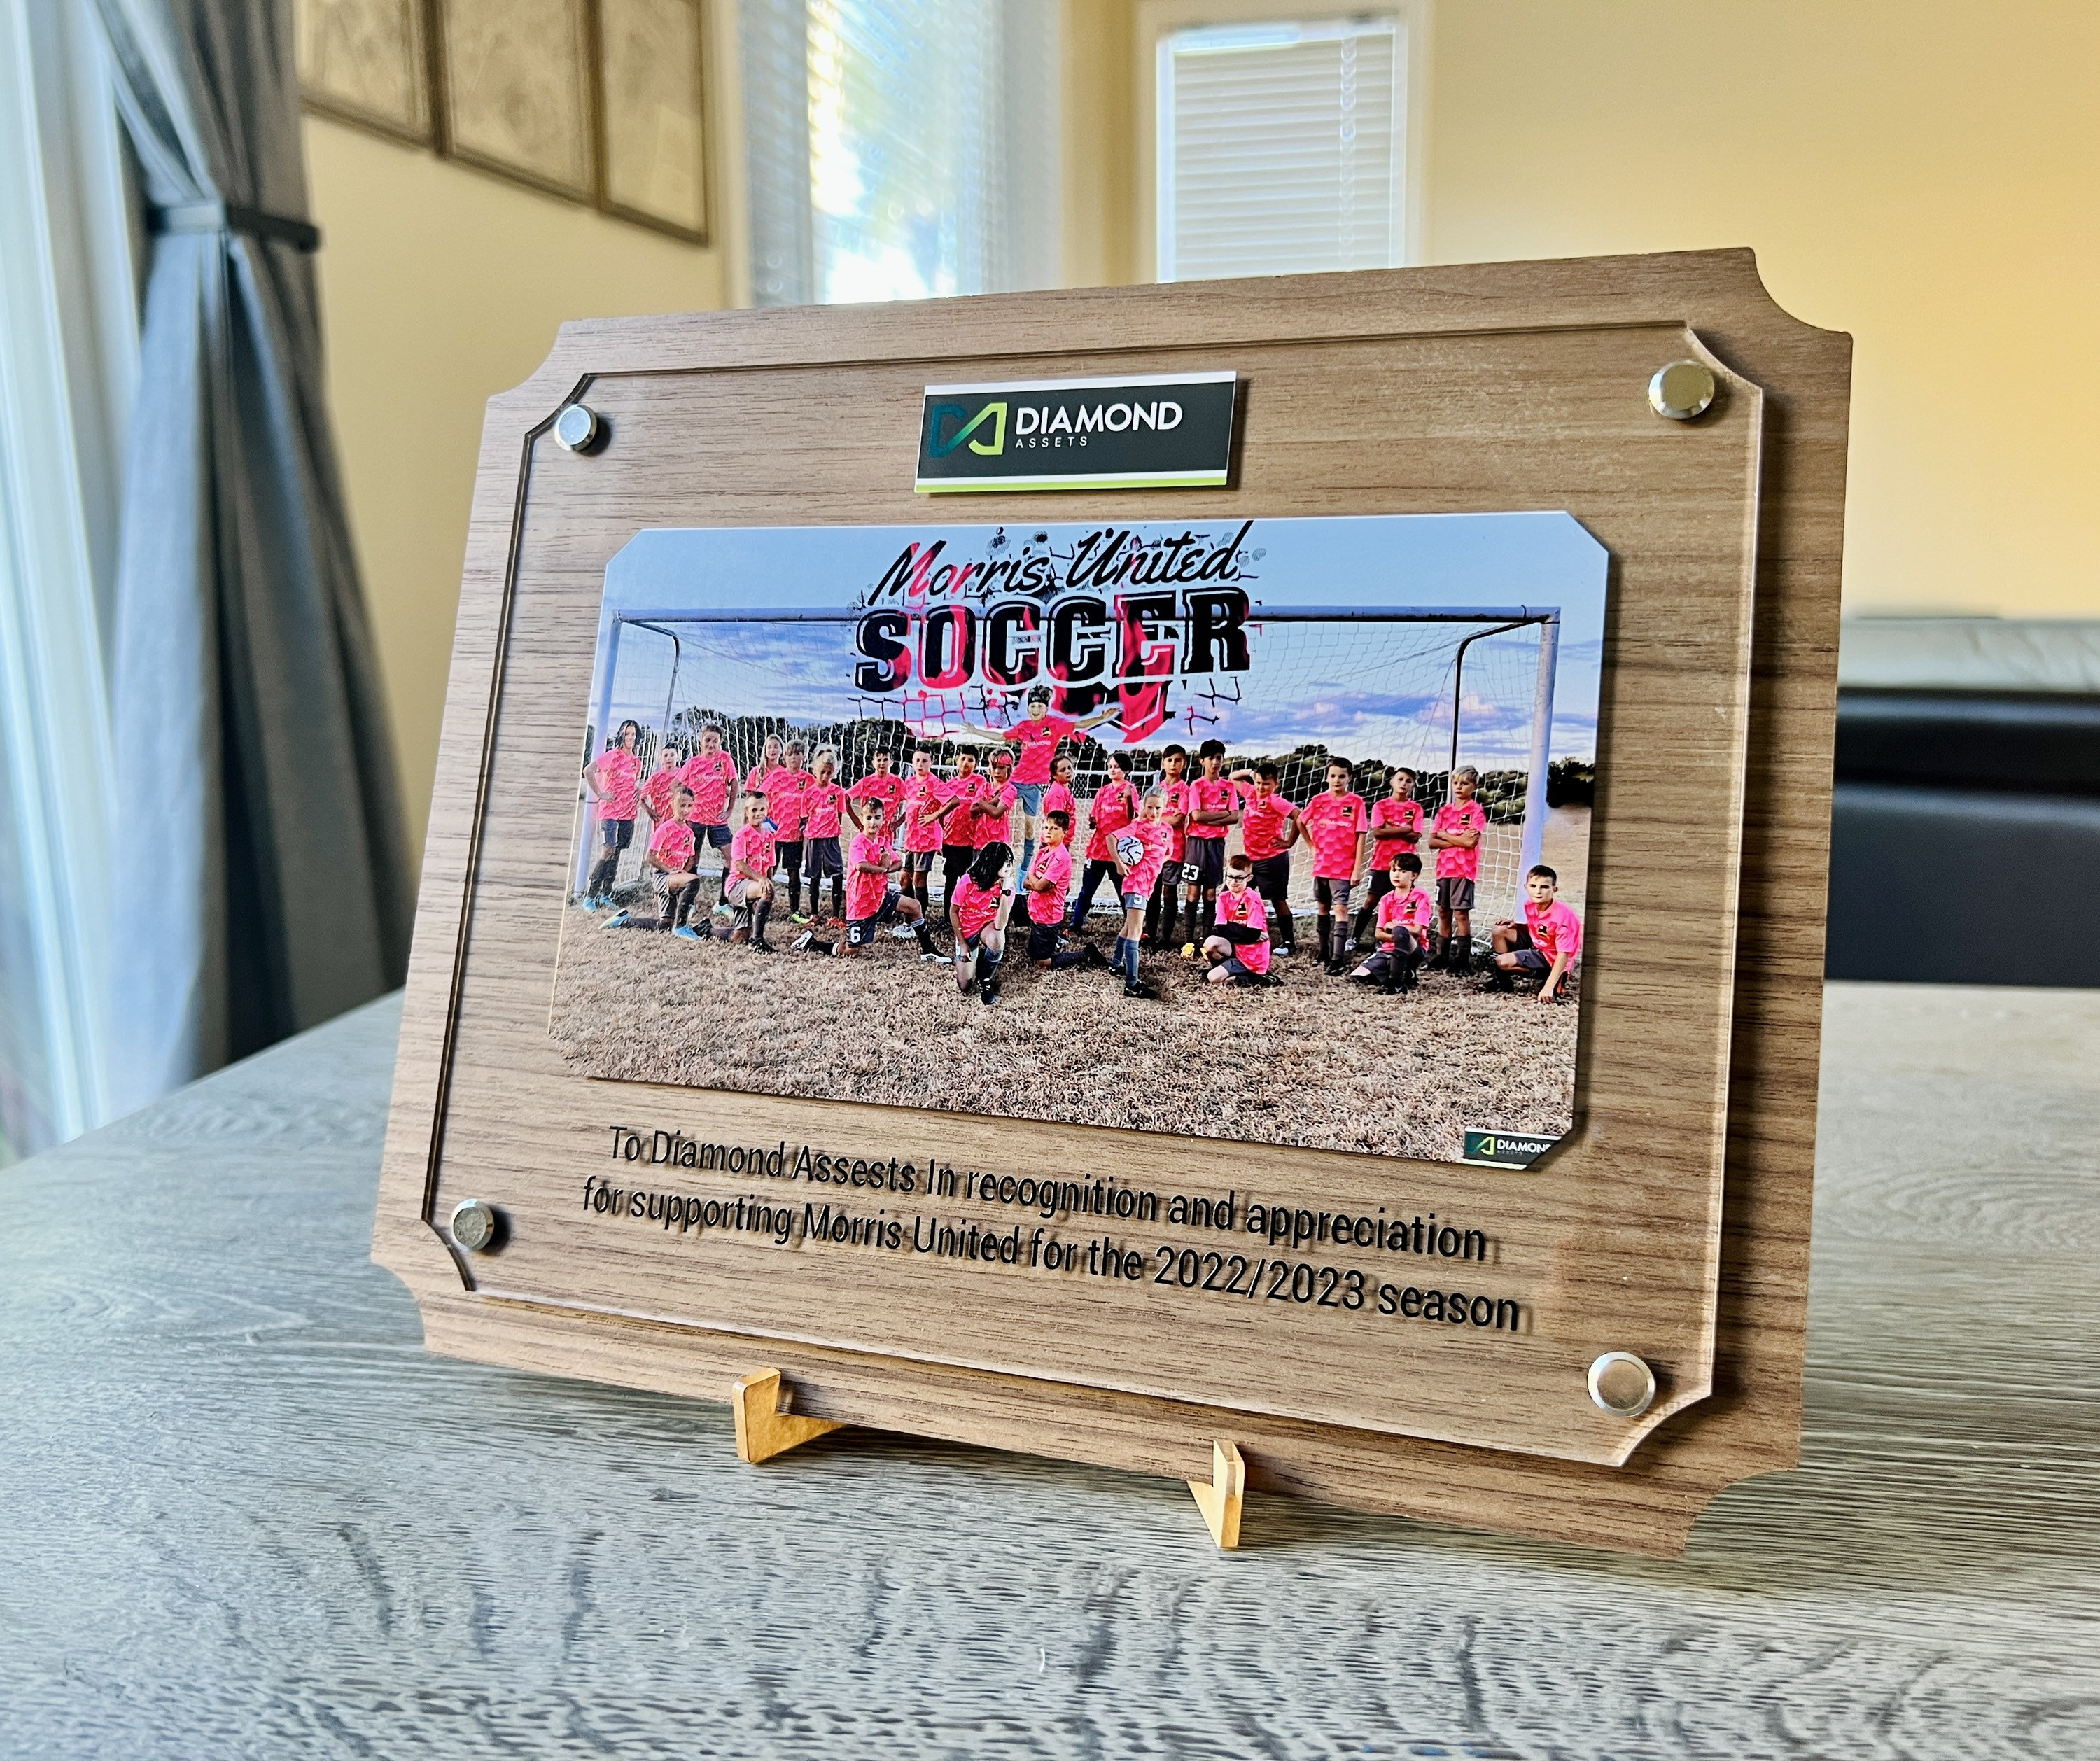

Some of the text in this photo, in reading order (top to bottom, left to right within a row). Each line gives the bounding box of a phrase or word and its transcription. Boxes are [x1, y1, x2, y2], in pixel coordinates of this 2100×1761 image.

[1015, 401, 1183, 435] DIAMOND
[1015, 436, 1088, 449] ASSETS
[867, 519, 1254, 607] Morris United
[855, 586, 1252, 693] SOCCER
[1181, 862, 1200, 881] 23
[850, 926, 861, 943] 6
[609, 1125, 1486, 1261] To Diamond Assests In recognition and appreciation
[582, 1174, 1519, 1331] for supporting Morris United for the 2022/2023 season
